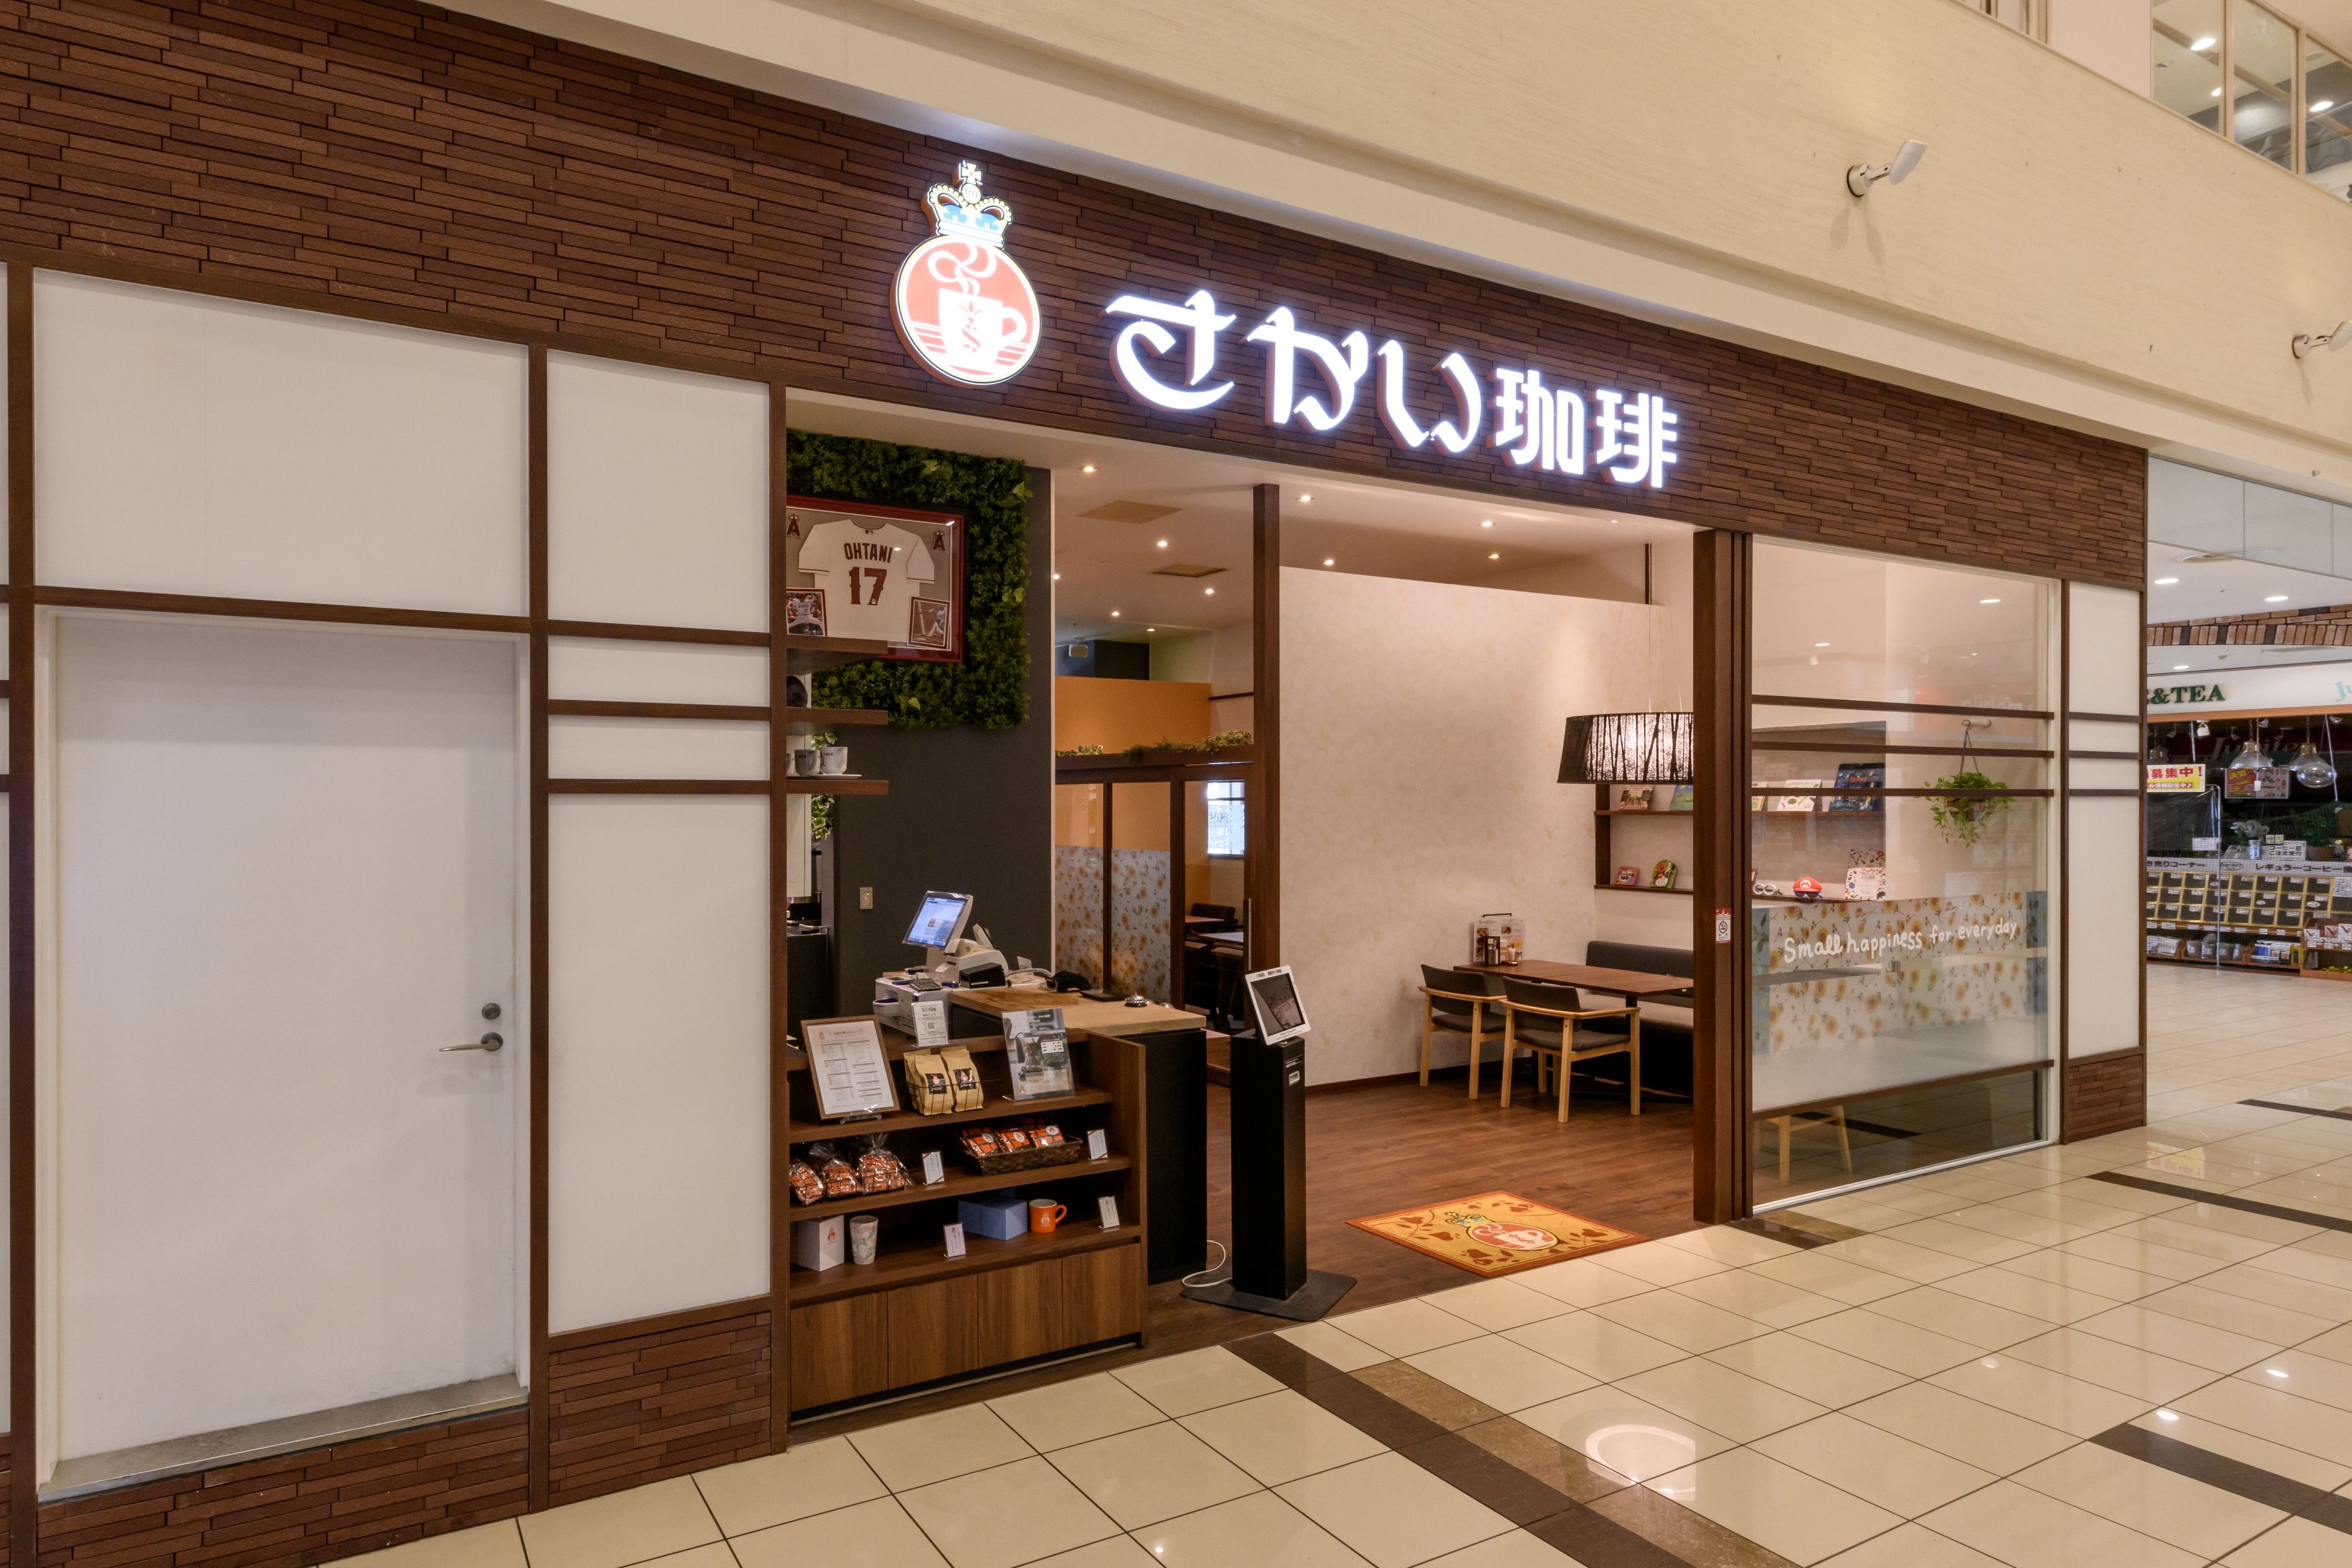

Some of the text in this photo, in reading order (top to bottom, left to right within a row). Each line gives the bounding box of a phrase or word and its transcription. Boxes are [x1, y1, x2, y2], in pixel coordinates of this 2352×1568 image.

[1106, 289, 1678, 489] さかい珈琲
[843, 542, 893, 564] OHTANI
[848, 567, 887, 606] 17
[2146, 684, 2226, 705] &TEA
[2146, 766, 2202, 779] 募集中!
[1784, 918, 2017, 963] Small happiness for everyday
